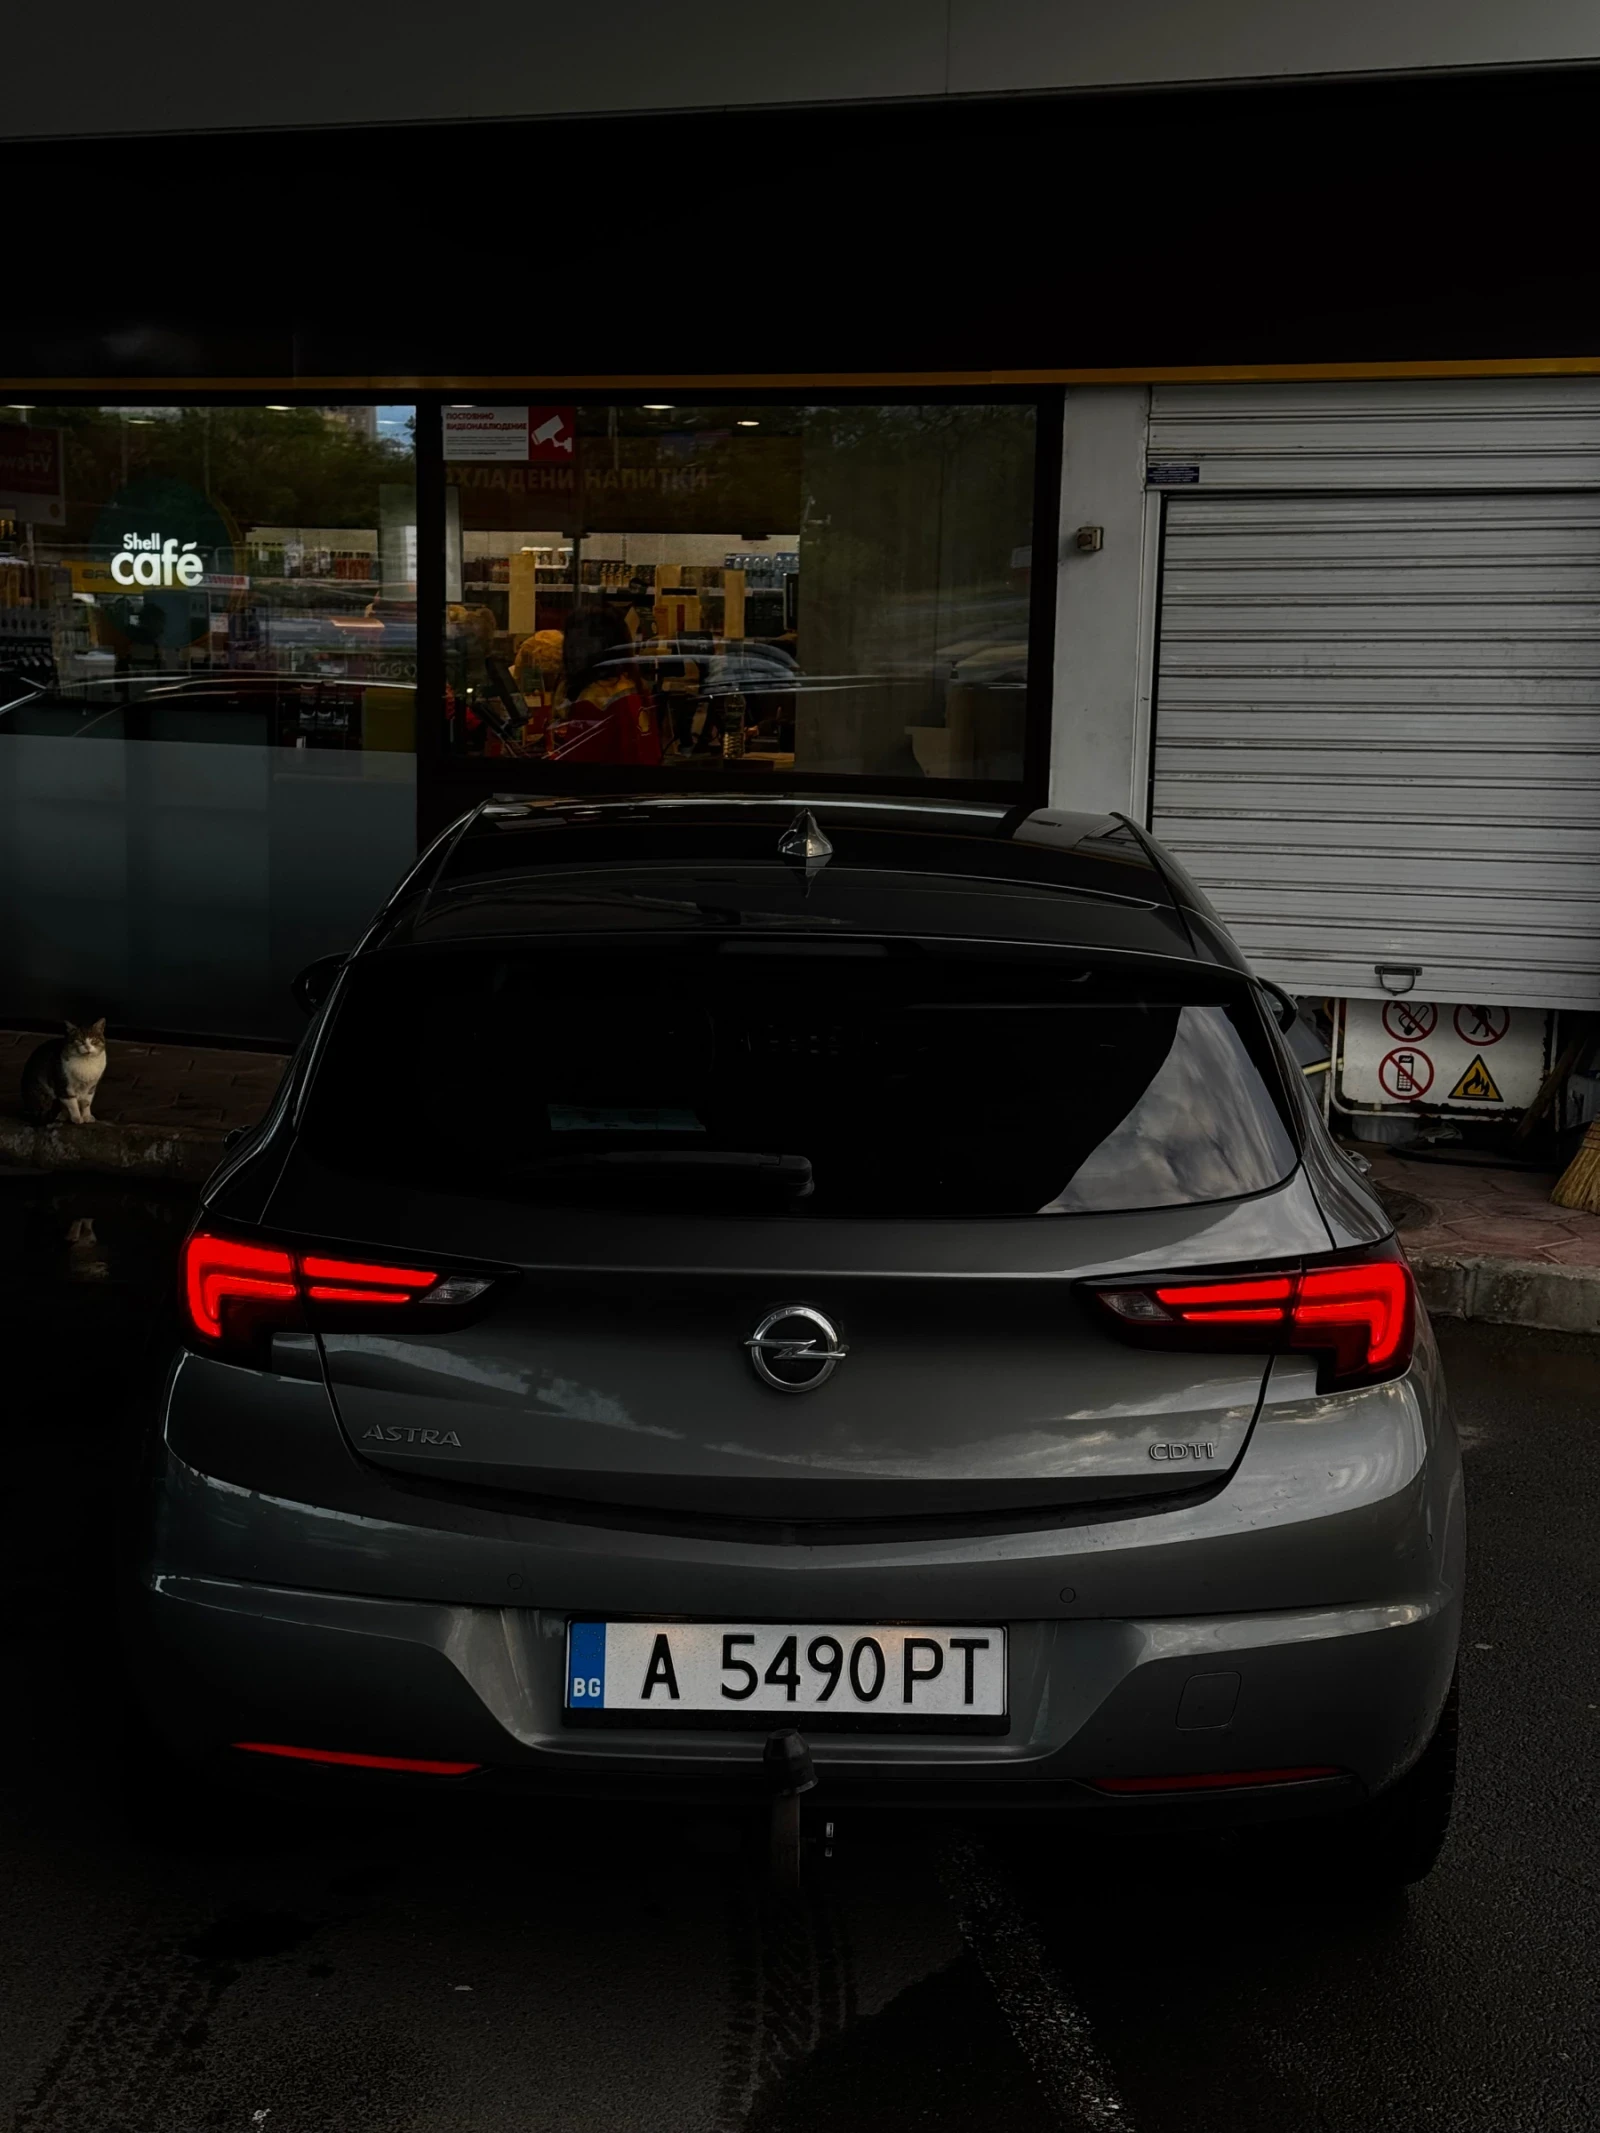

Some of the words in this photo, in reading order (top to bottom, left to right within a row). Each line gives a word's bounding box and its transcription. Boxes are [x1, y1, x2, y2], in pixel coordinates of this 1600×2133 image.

[585, 467, 708, 491] НАПИТКИ
[123, 532, 160, 550] Shell
[111, 538, 203, 586] café
[362, 1424, 462, 1447] ASTRA
[1149, 1442, 1214, 1460] CDTI
[641, 1633, 680, 1699] A
[722, 1634, 885, 1702] 5490
[904, 1637, 989, 1704] PT
[573, 1677, 601, 1697] BG
